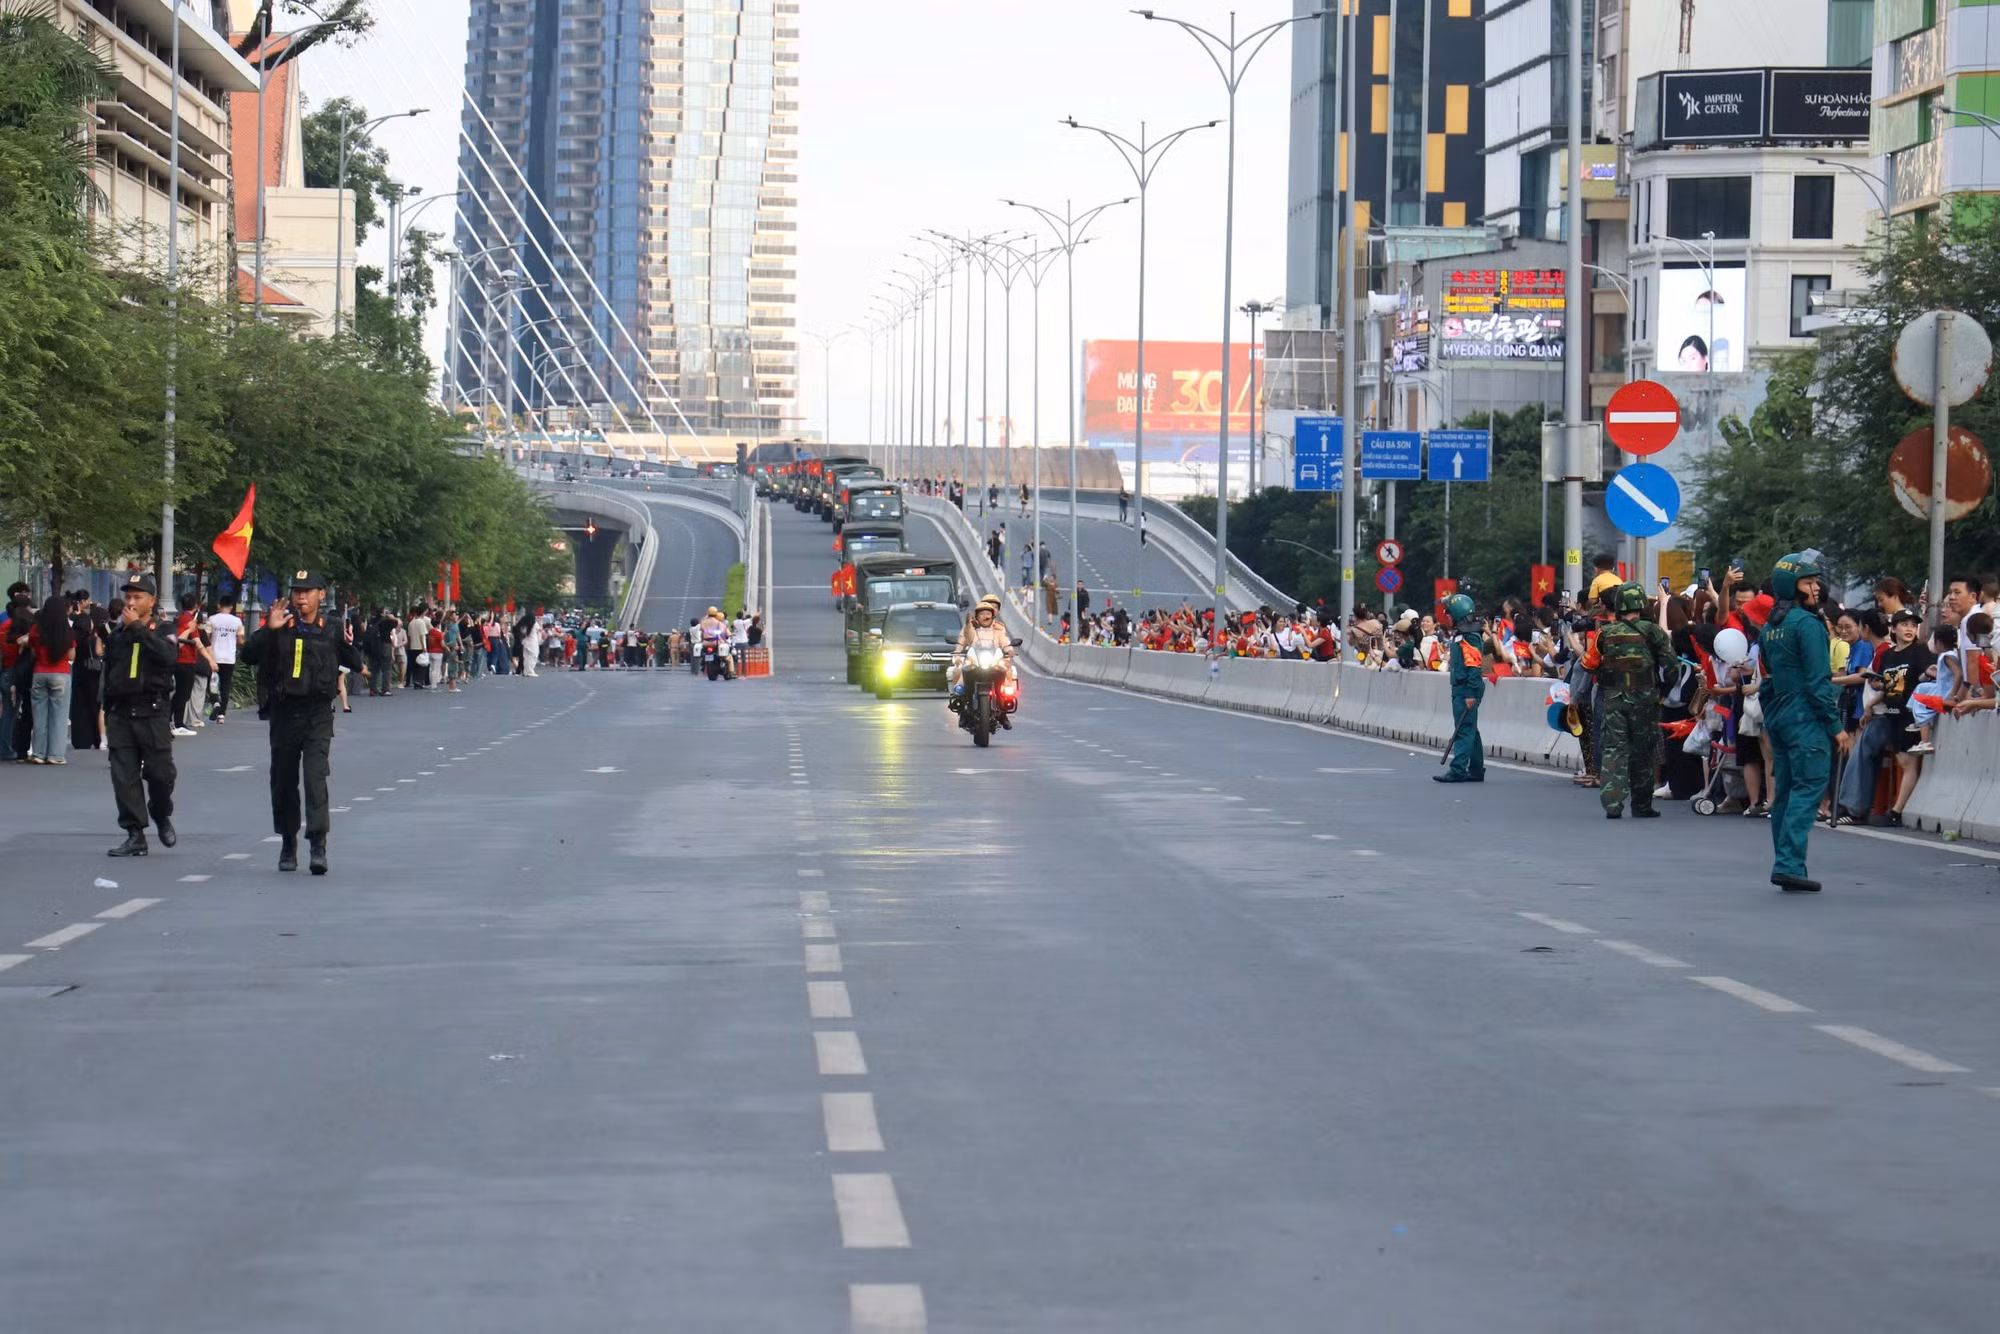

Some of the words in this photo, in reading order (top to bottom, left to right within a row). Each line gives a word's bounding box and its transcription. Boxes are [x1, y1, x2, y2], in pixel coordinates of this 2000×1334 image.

[1704, 93, 1743, 104] IMPERIAL
[1818, 93, 1849, 104] HOÀN
[1704, 104, 1739, 115] CENTER
[1819, 105, 1861, 120] Perfection
[1463, 313, 1543, 342] 명동관
[1443, 343, 1491, 357] MYEONG
[1493, 344, 1526, 357] DONG
[1529, 344, 1562, 357] QUAN
[1386, 440, 1396, 449] BA
[1397, 440, 1411, 449] SON
[1568, 555, 1578, 564] 05
